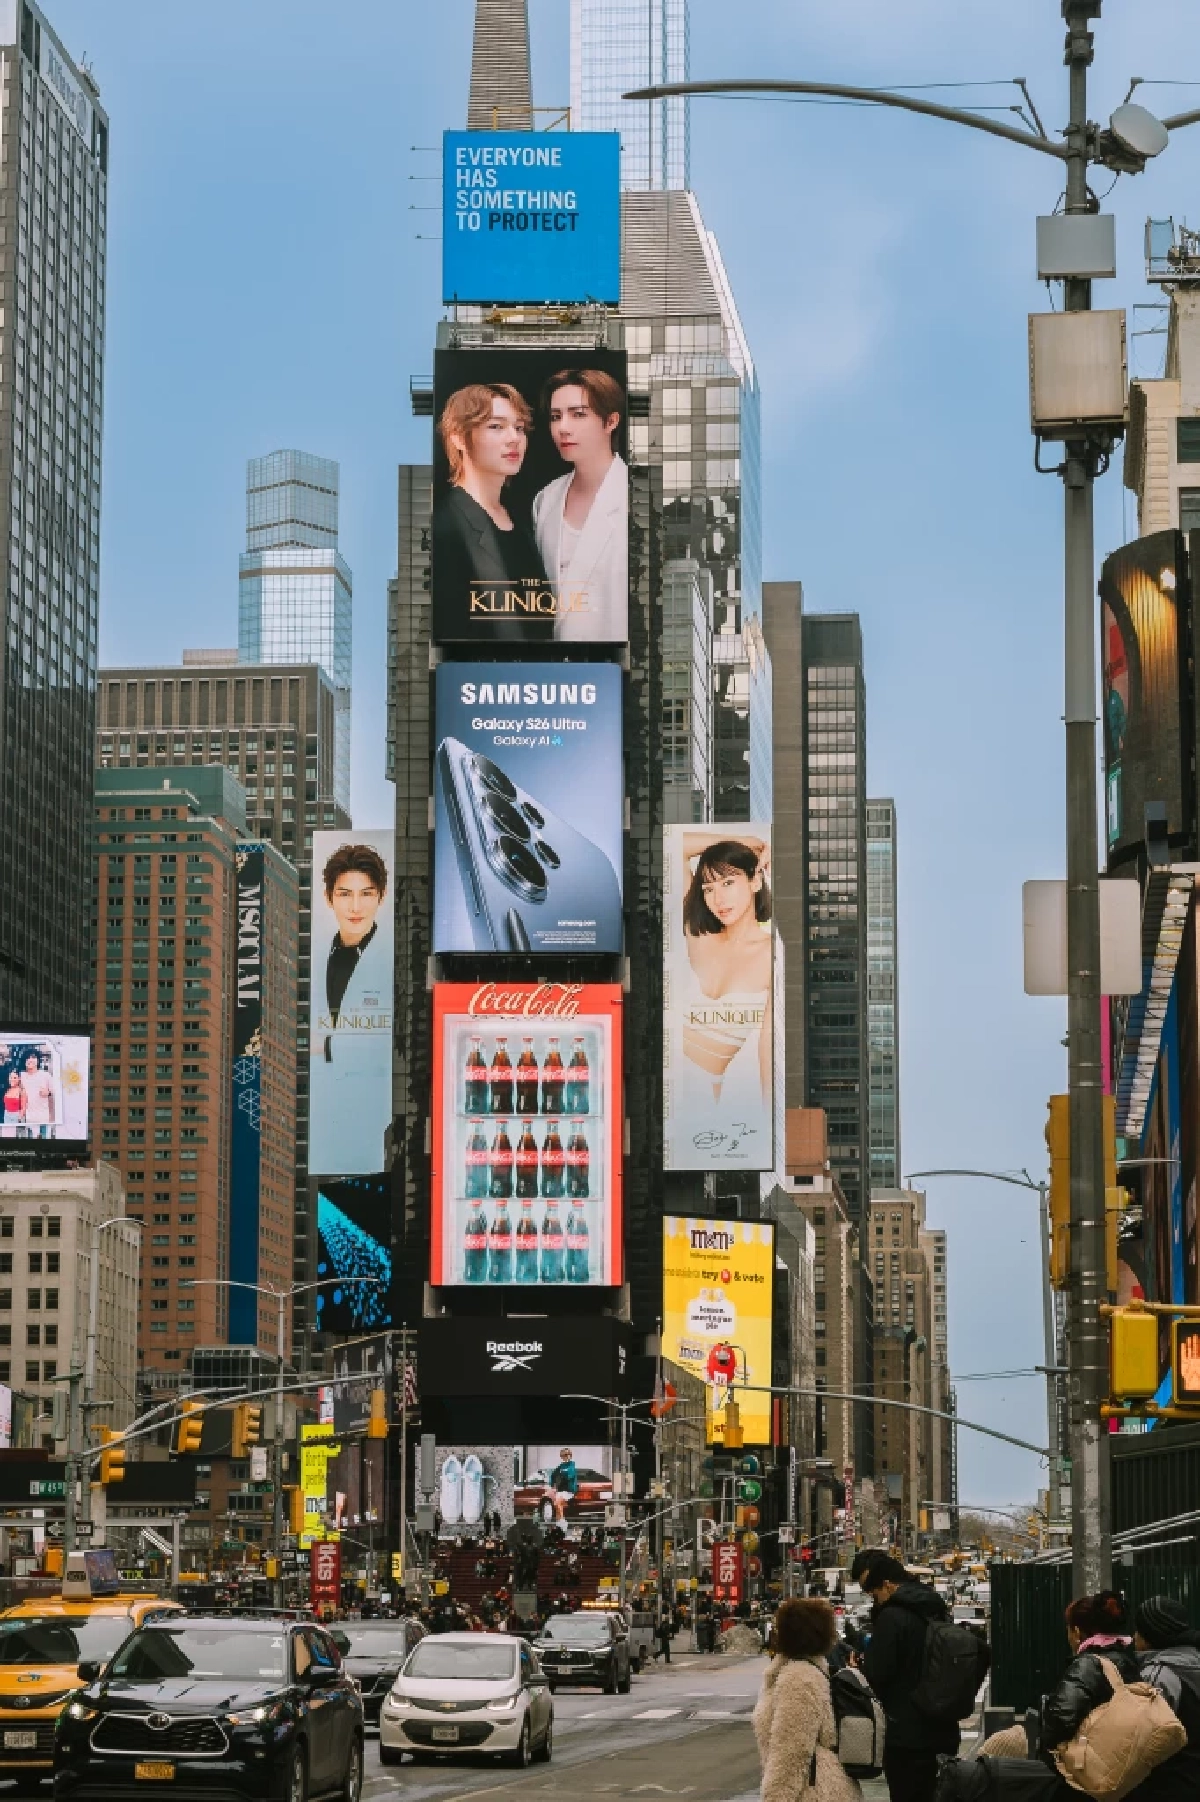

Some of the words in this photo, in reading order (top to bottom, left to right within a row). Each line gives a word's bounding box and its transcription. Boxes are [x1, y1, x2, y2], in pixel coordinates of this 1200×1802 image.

[456, 148, 562, 166] EVERYONE
[456, 169, 497, 187] HAS
[456, 191, 576, 209] SOMETHING
[456, 211, 481, 231] TO
[488, 212, 579, 231] PROTECT
[470, 591, 590, 614] KLINIQUE
[461, 683, 597, 704] SAMSUNG
[472, 718, 523, 732] Galaxy
[525, 718, 549, 730] S26
[553, 718, 587, 730] Ultra
[493, 736, 537, 748] Galaxy
[468, 983, 583, 1020] Coca-Cola
[486, 1341, 543, 1353] Reebok
[317, 1543, 337, 1580] tkts
[719, 1545, 738, 1583] tkts
